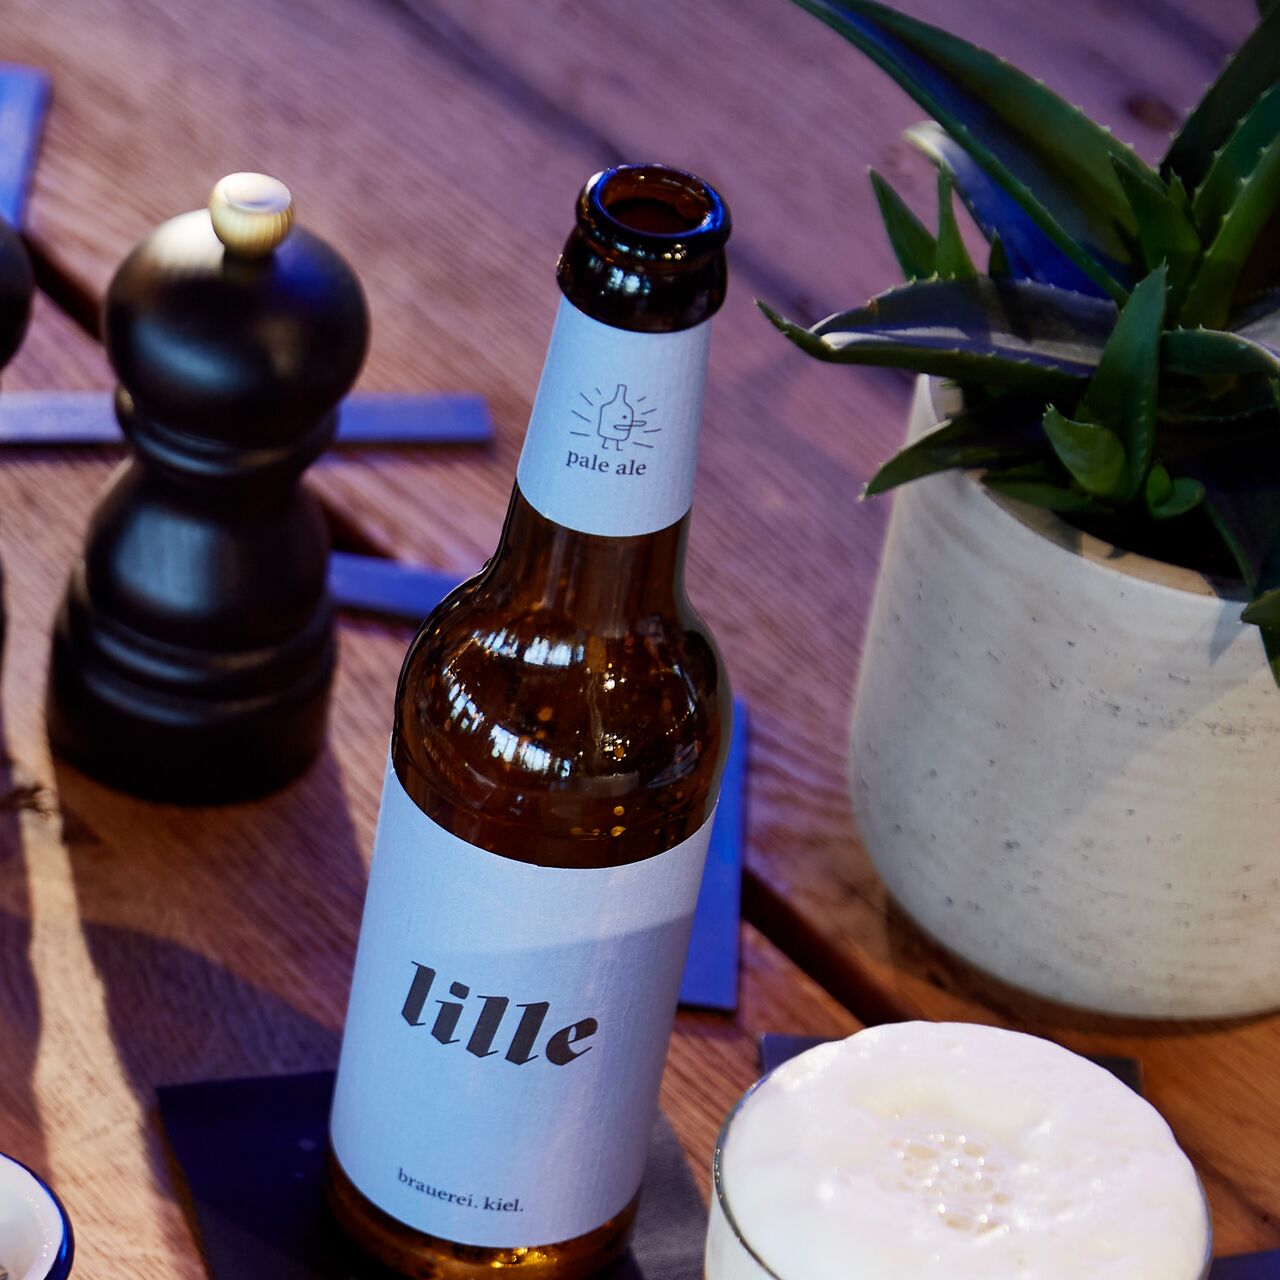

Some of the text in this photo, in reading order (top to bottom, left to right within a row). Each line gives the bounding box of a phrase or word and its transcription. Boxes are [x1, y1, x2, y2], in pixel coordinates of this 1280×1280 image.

[566, 450, 646, 476] pale ale
[400, 960, 598, 1067] lille
[398, 1166, 524, 1212] brauerei. kiel.
